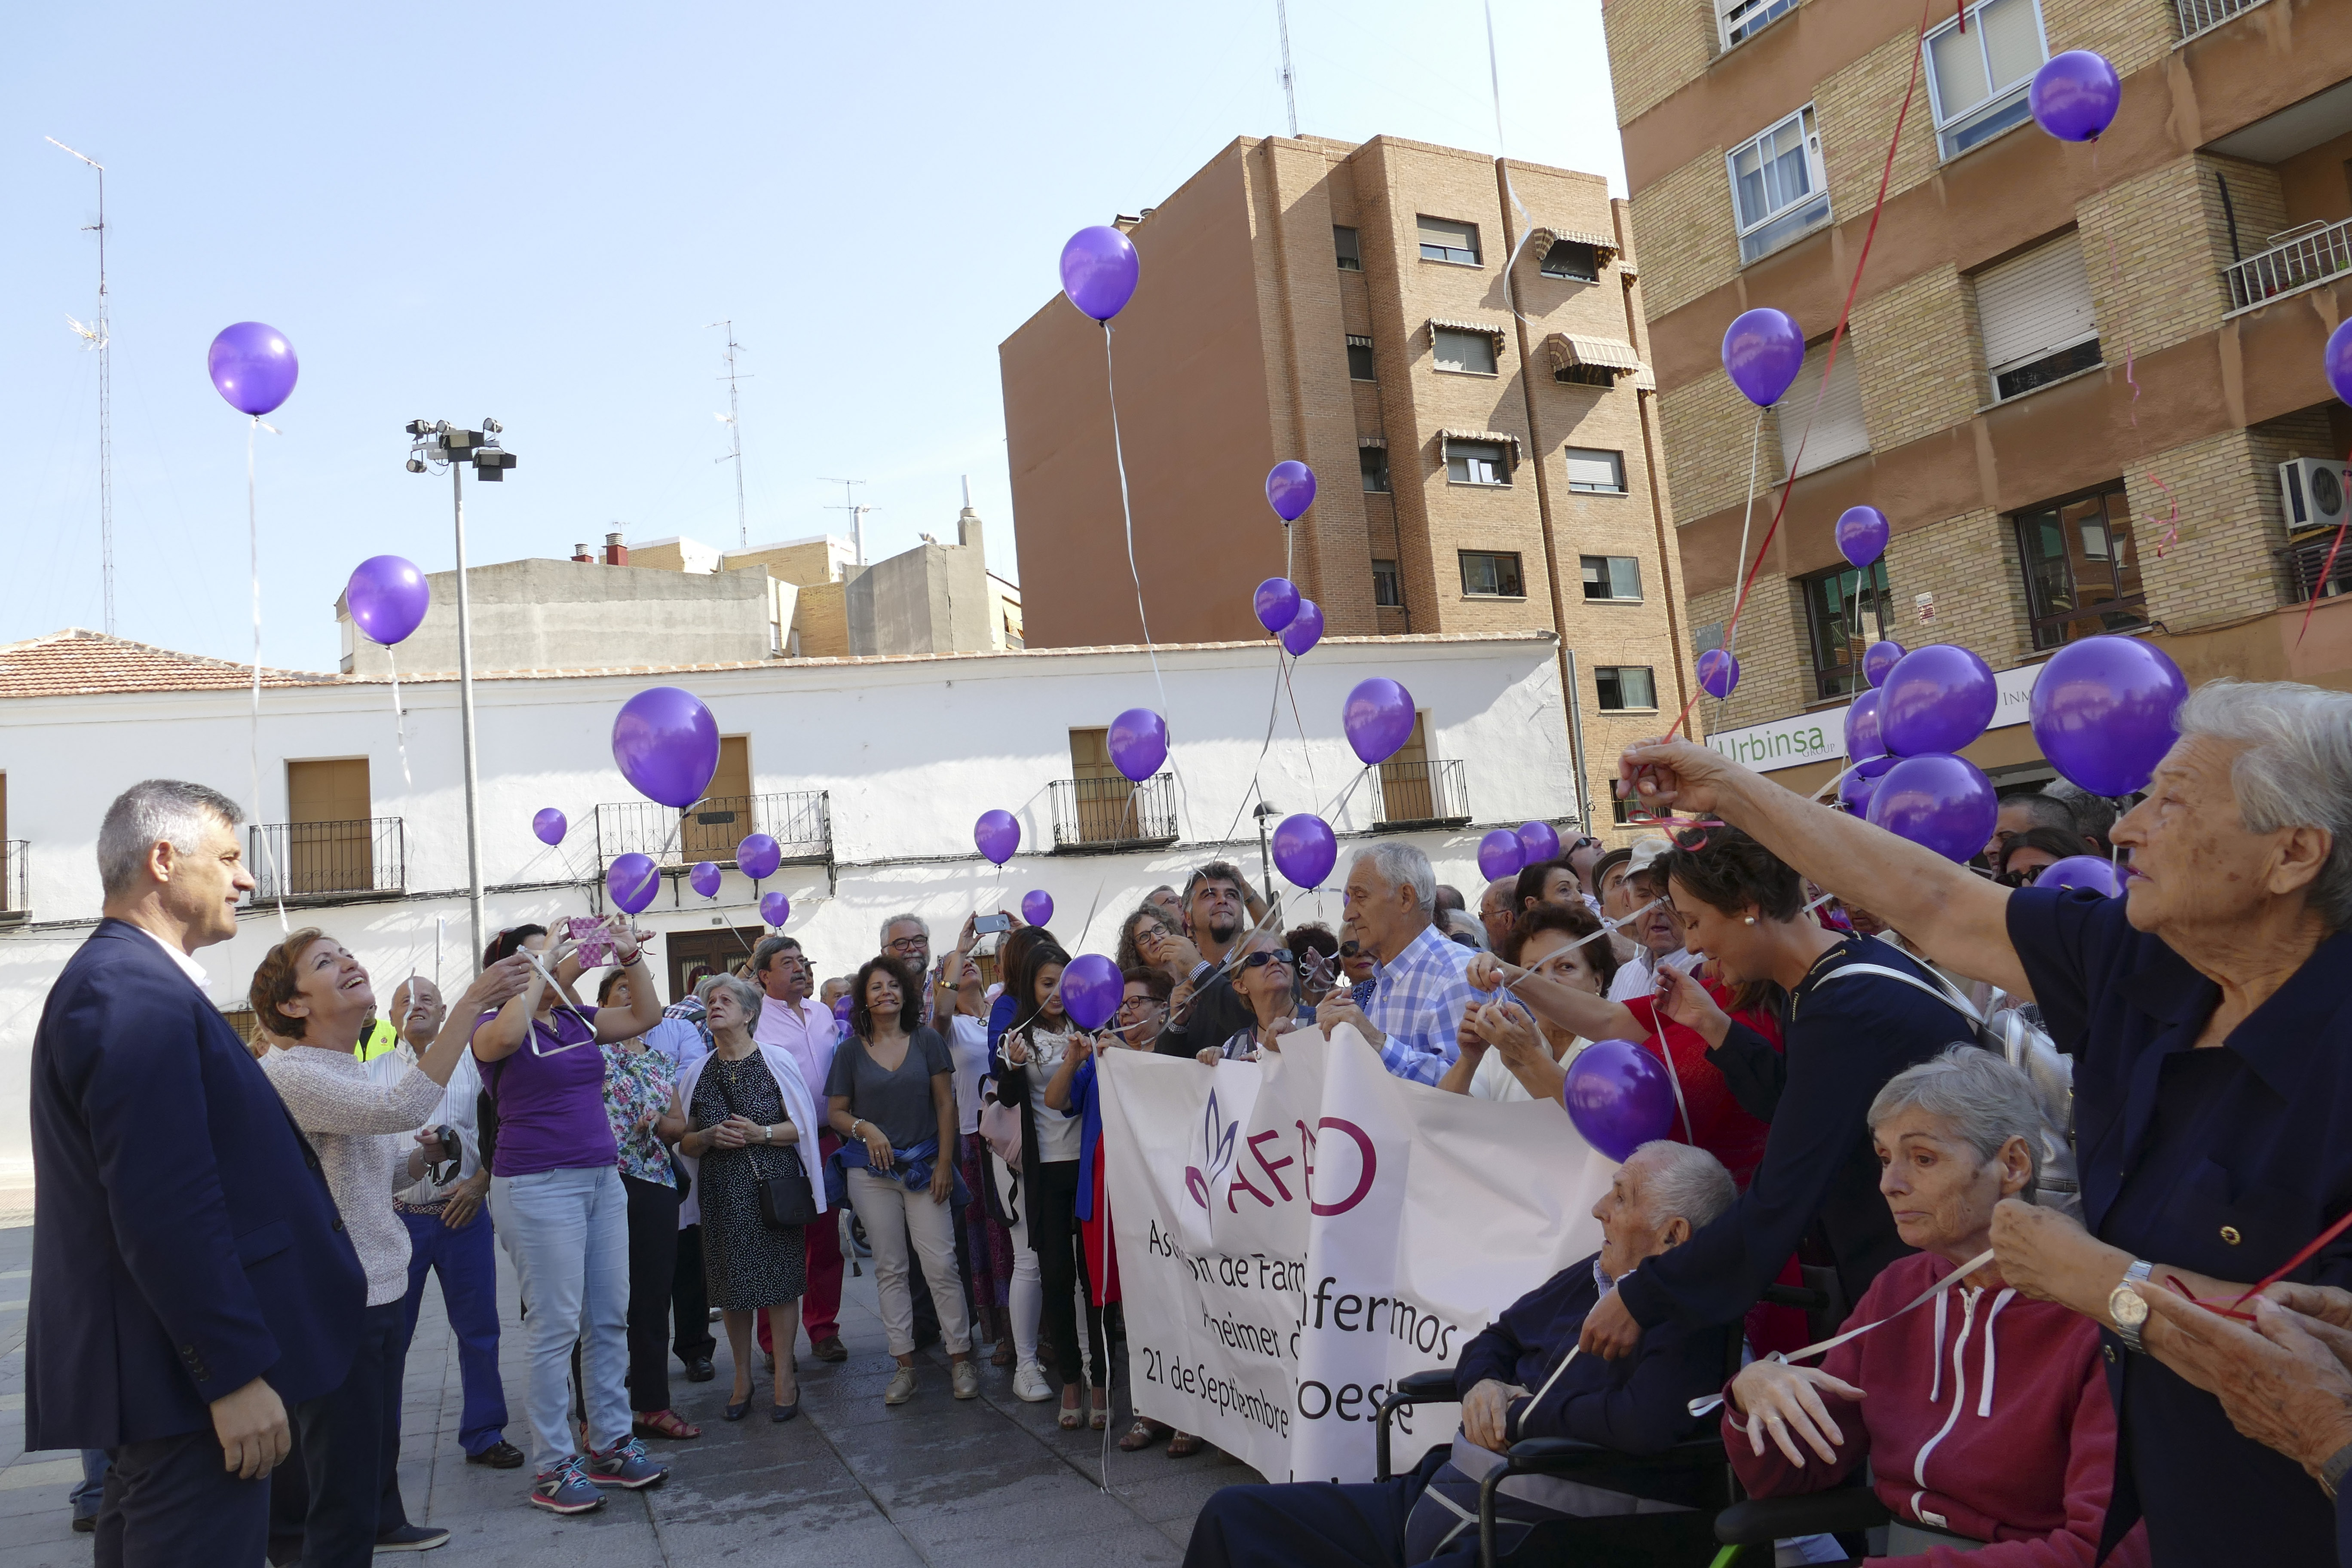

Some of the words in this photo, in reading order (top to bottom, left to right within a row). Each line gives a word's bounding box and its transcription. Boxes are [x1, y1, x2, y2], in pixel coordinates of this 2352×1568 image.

[1701, 625, 1717, 634] PLAZA
[1719, 727, 1824, 763] Urbinsa
[1802, 743, 1835, 757] GROUP
[1219, 1253, 1249, 1288] de
[1143, 1347, 1164, 1384] 21
[1171, 1355, 1195, 1393] de
[1198, 1364, 1289, 1439] Septiembre
